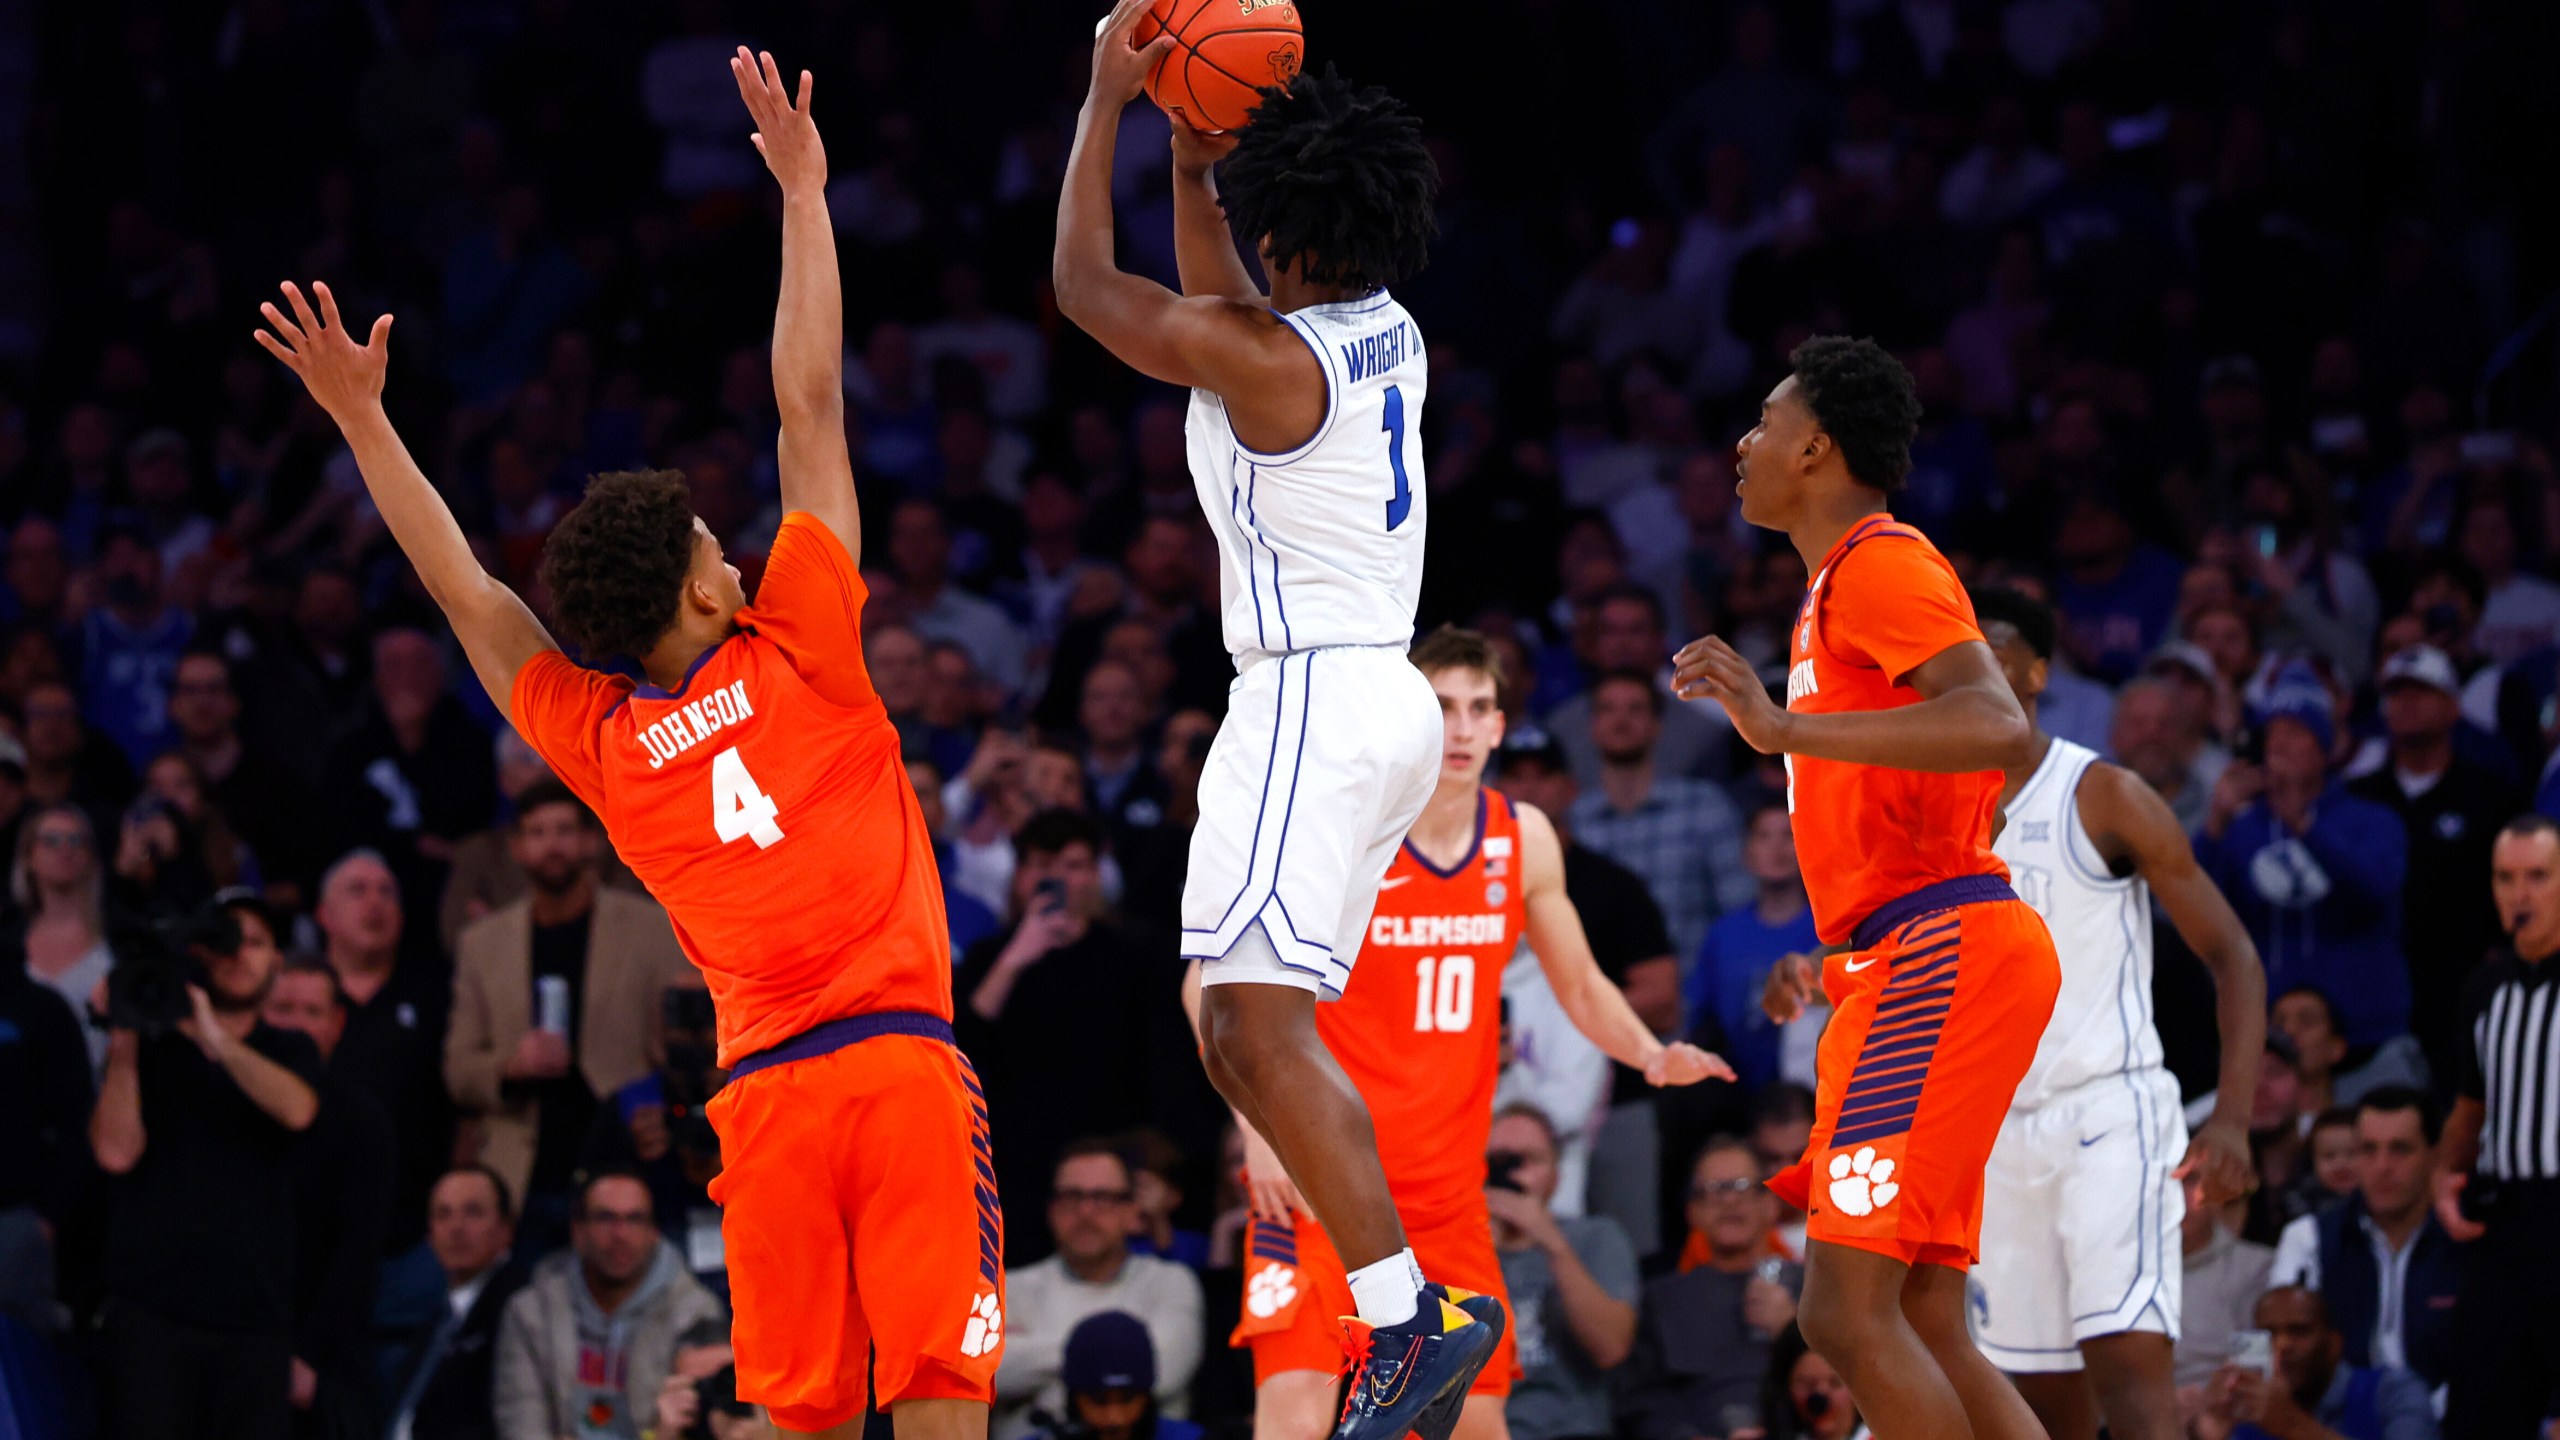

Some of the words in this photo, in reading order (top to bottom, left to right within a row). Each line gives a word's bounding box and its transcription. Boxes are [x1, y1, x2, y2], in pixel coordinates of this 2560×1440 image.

[1341, 320, 1406, 384] WRIGHT
[1382, 384, 1412, 532] 1
[637, 679, 754, 769] JOHNSON
[712, 745, 786, 850] 4
[1371, 914, 1506, 946] CLEMSON
[1414, 955, 1475, 1032] 10
